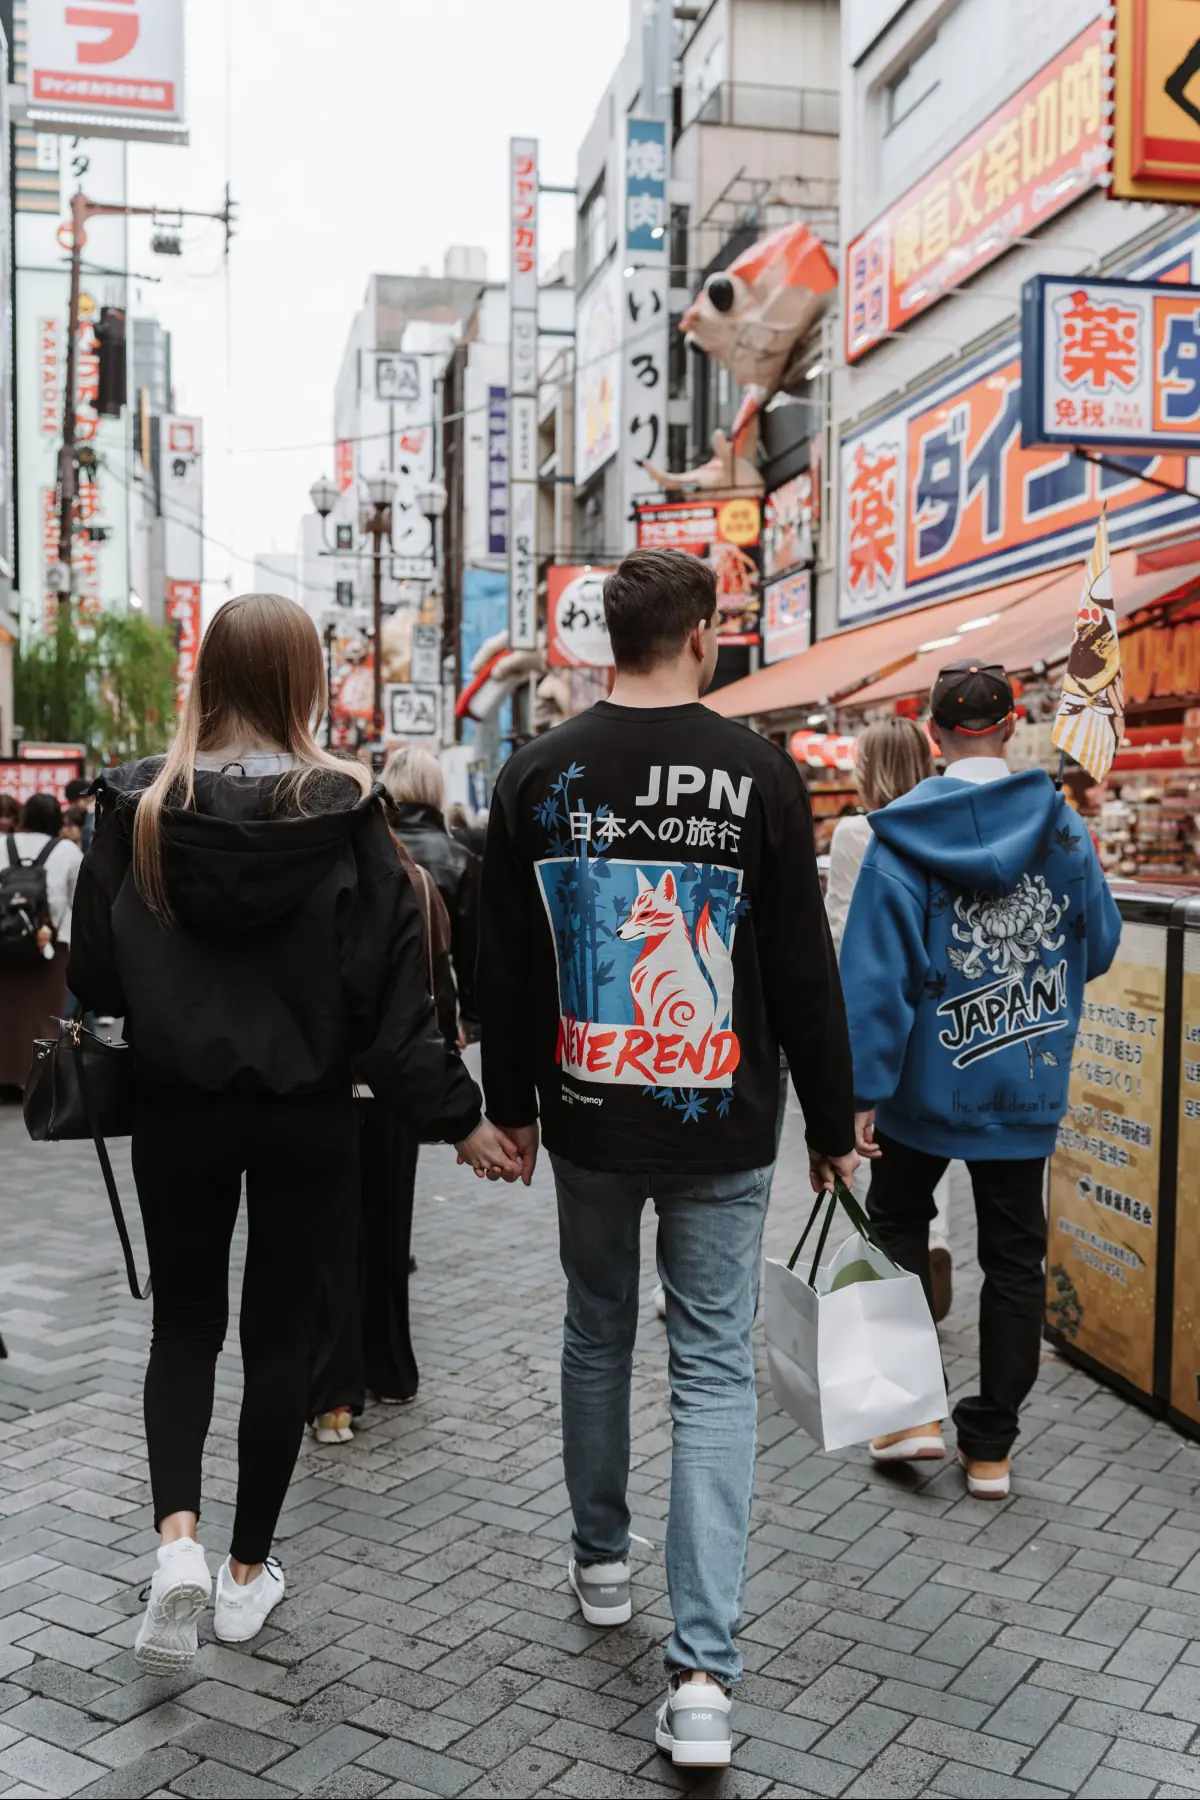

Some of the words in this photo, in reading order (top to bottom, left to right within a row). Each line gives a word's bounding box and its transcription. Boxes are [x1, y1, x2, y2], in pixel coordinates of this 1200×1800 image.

[627, 139, 666, 230] 焼肉
[42, 319, 59, 432] KARAOKE
[628, 290, 661, 468] いろり
[1063, 305, 1138, 388] 薬
[1055, 398, 1106, 428] 免税
[849, 443, 898, 592] 薬
[635, 765, 753, 818] JPN
[569, 811, 742, 854] 日本への旅行
[937, 959, 1068, 1050] JAPAN!
[555, 1013, 741, 1084] NEVEREND
[580, 1095, 604, 1106] agency
[691, 1713, 712, 1721] DIOR
